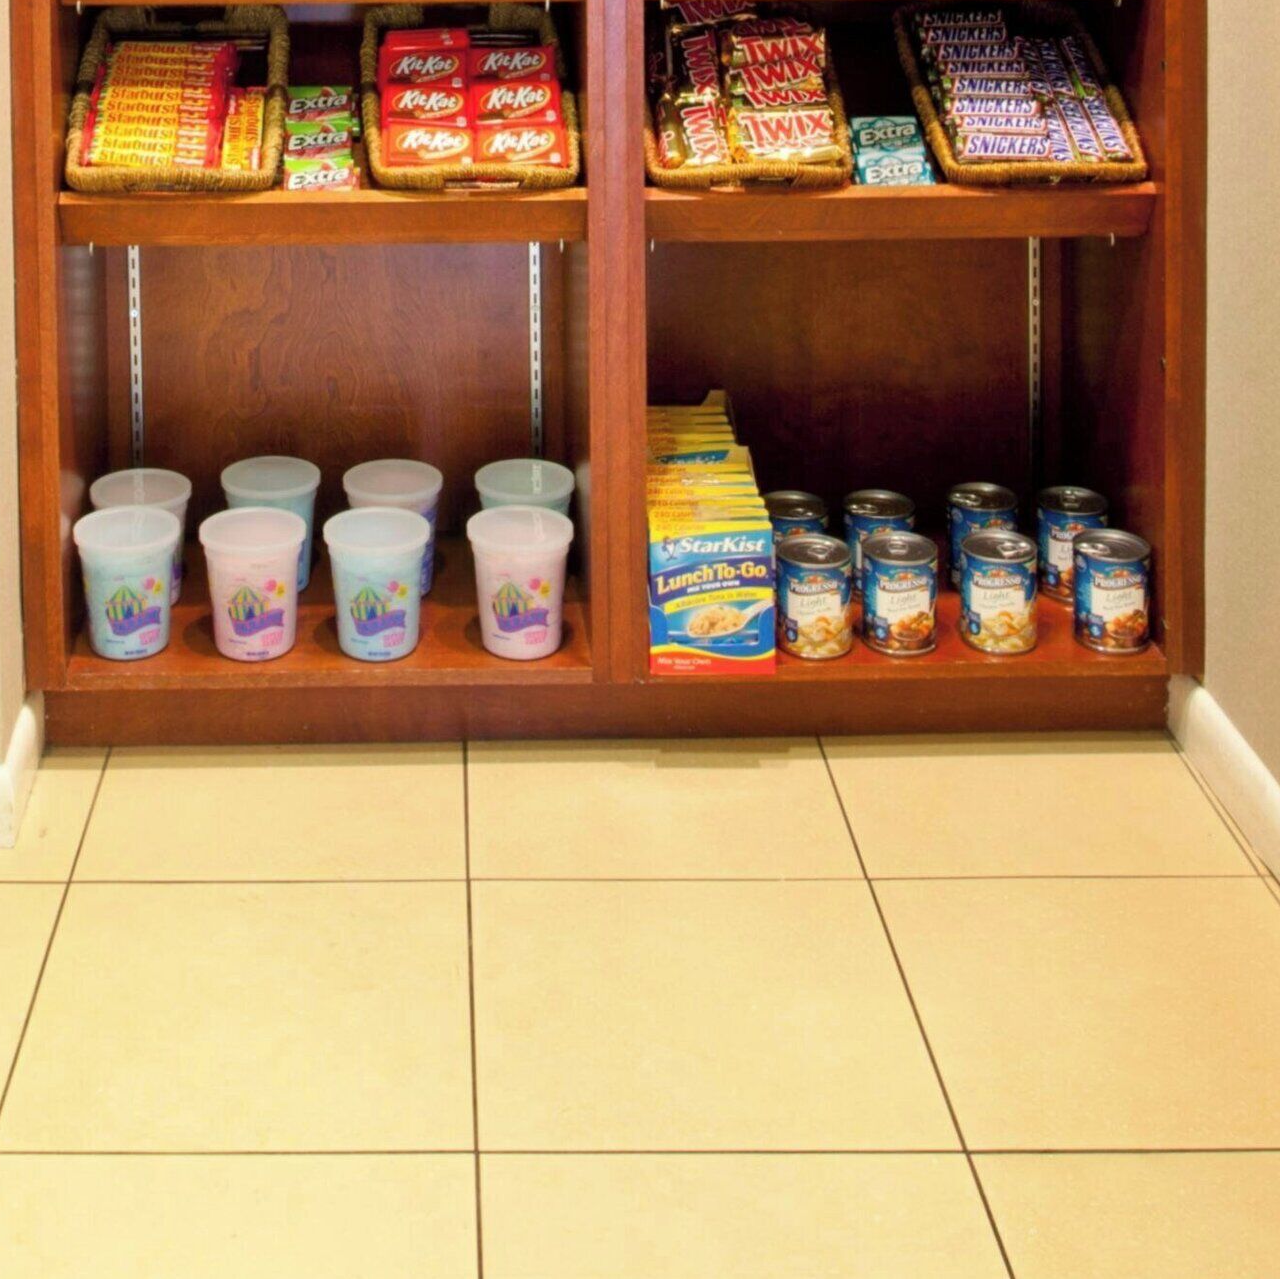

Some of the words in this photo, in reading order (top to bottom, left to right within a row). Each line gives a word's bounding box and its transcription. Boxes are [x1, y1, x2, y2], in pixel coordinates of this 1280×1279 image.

[930, 27, 1006, 43] SNICKERS
[739, 32, 825, 64] TWIX
[940, 43, 1018, 60] SNICKERS
[740, 55, 820, 93] TWIX
[955, 77, 1031, 94] SNICKERS
[289, 94, 348, 115] Extra
[954, 97, 1033, 114] SNICKERS
[287, 131, 348, 151] Extra
[740, 112, 833, 150] TWIX
[859, 124, 917, 144] Extra
[967, 135, 1050, 156] SNICKERS
[287, 168, 349, 190] Extra
[865, 161, 924, 182] Extra
[679, 535, 766, 554] StarKist
[656, 565, 713, 596] Lunch
